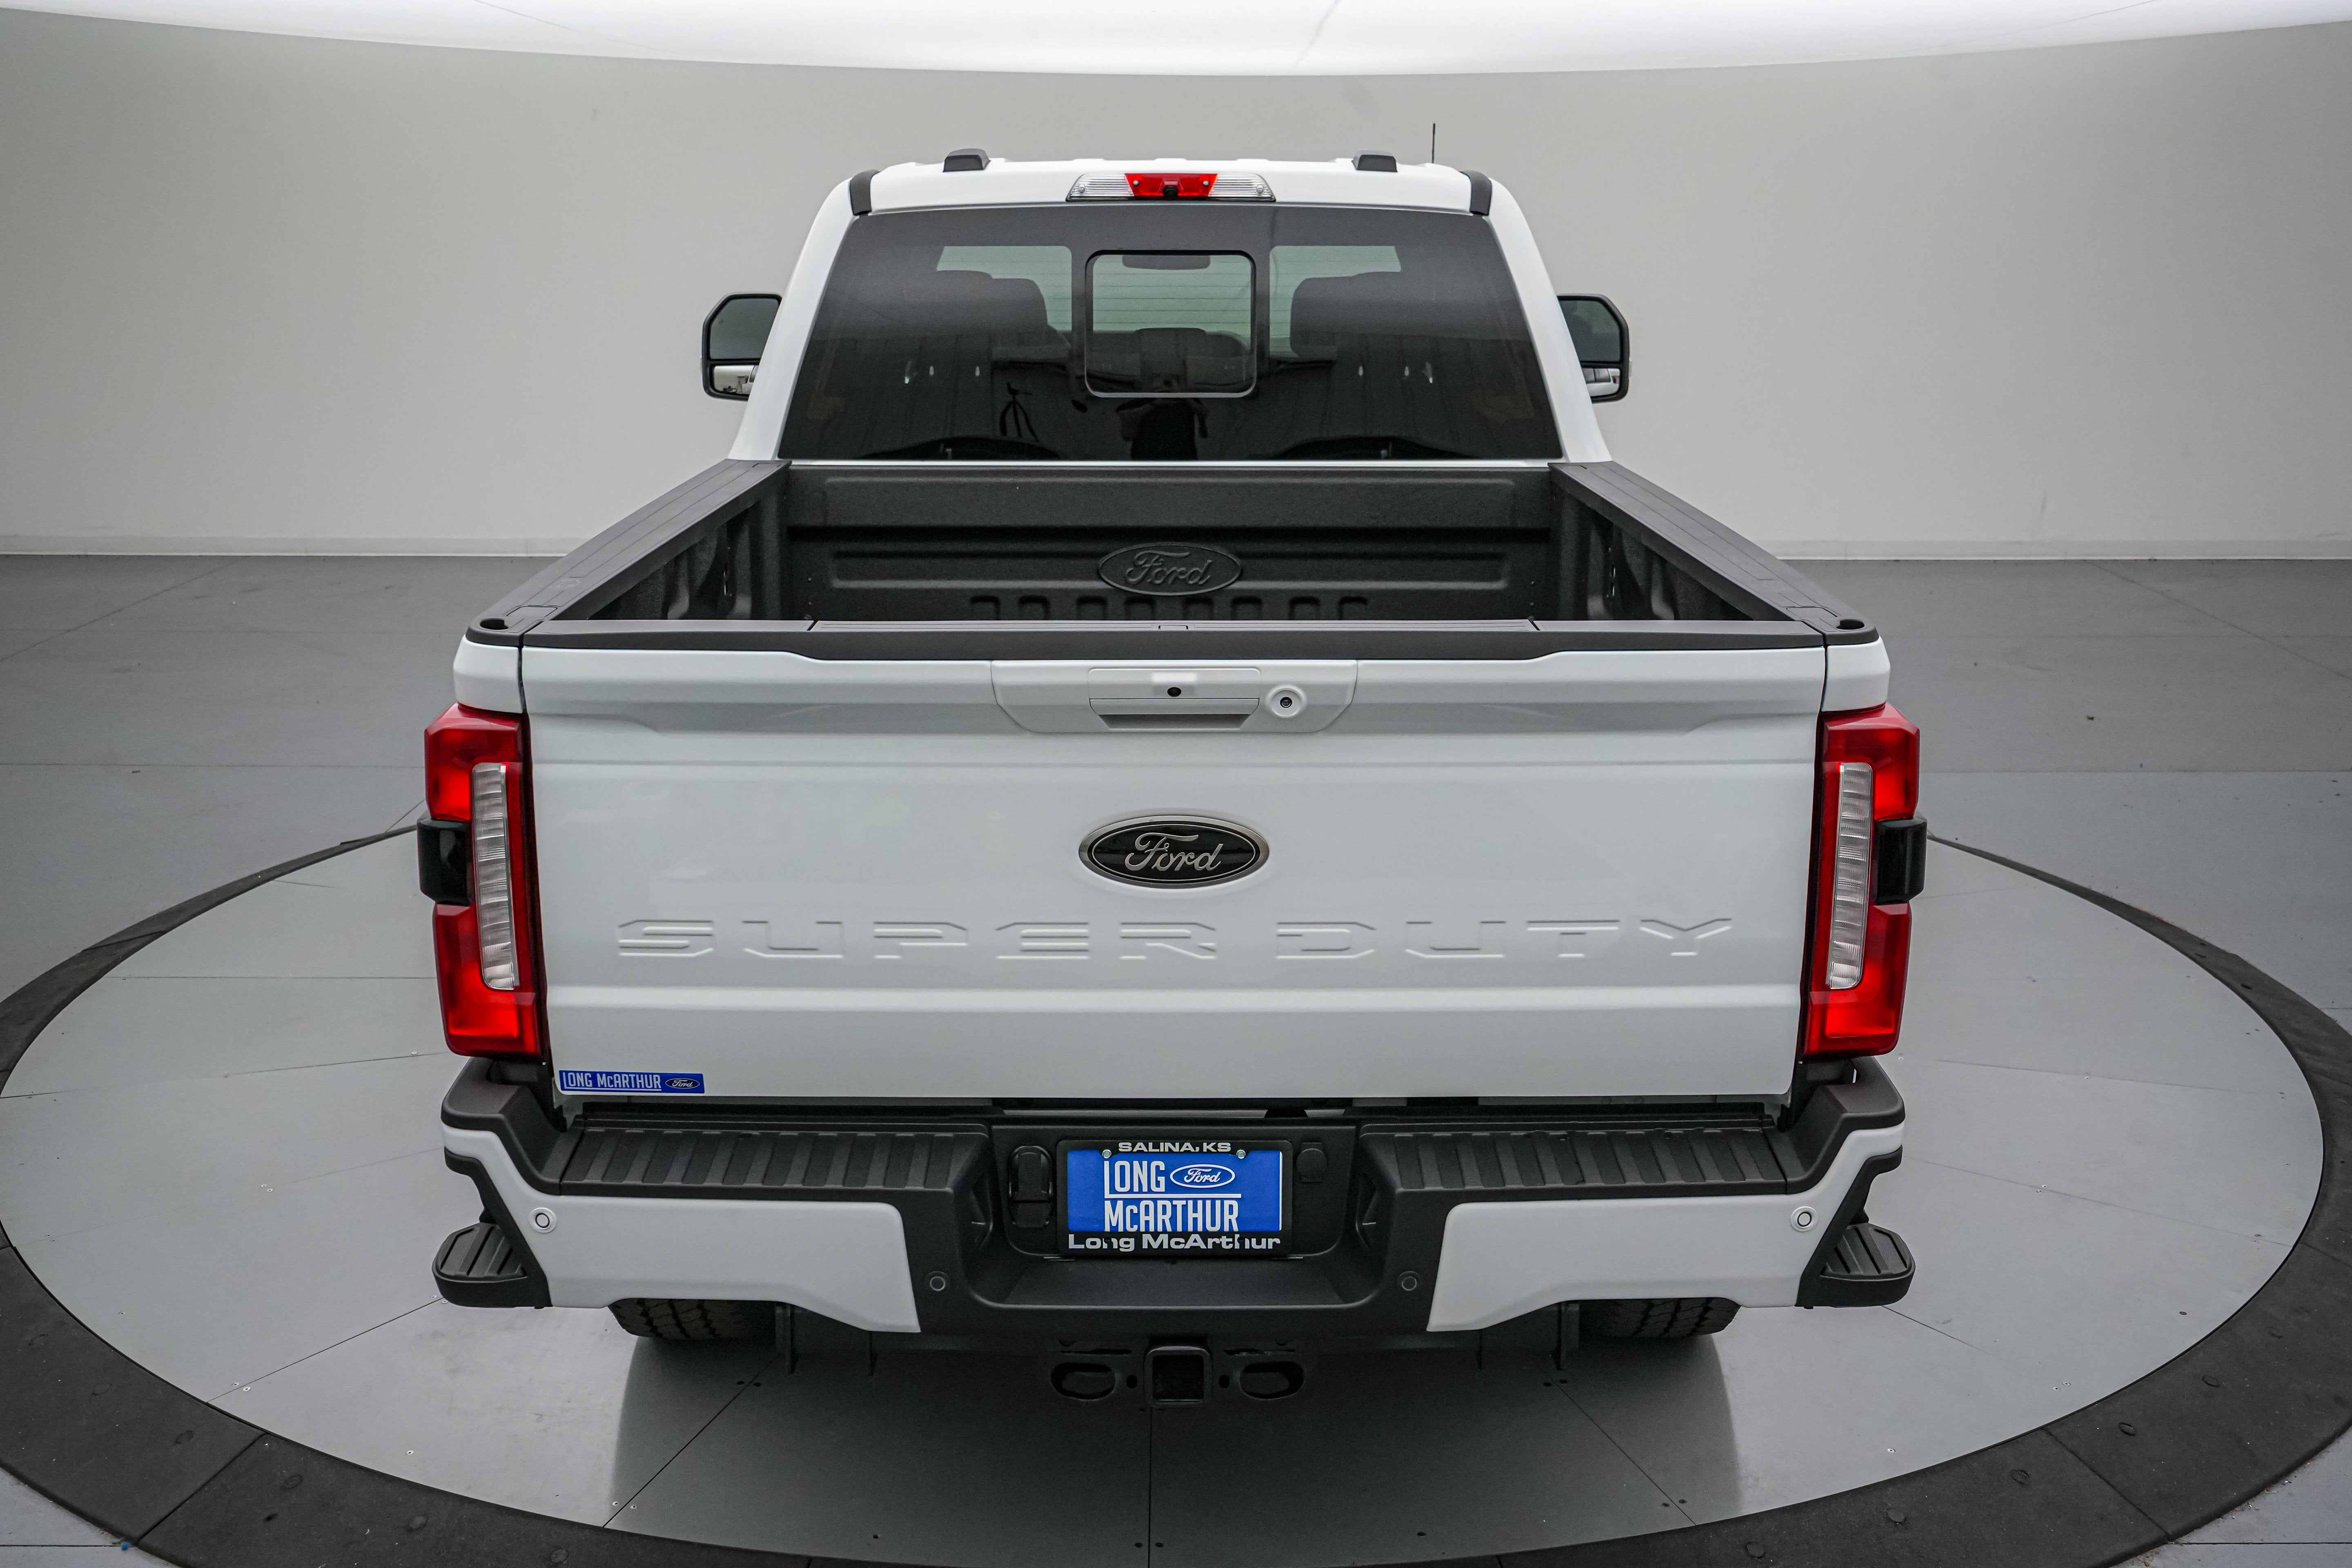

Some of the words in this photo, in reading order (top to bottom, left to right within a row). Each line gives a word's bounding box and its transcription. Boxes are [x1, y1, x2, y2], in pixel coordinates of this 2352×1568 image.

[1125, 550, 1213, 585] Ford
[1125, 832, 1224, 871] Ford
[617, 919, 1217, 960] SUPER
[1276, 918, 1732, 959] DUTY
[563, 1072, 592, 1089] LONG
[597, 1073, 662, 1089] McARTHUR
[672, 1079, 693, 1088] Ford
[1118, 1142, 1200, 1152] SALINA,
[1203, 1142, 1232, 1152] KS
[1104, 1160, 1165, 1198] LONG
[1184, 1168, 1222, 1183] Ford
[1104, 1200, 1238, 1232] McARTHUR
[1068, 1234, 1135, 1252] Long
[1142, 1234, 1281, 1249] McArthur
